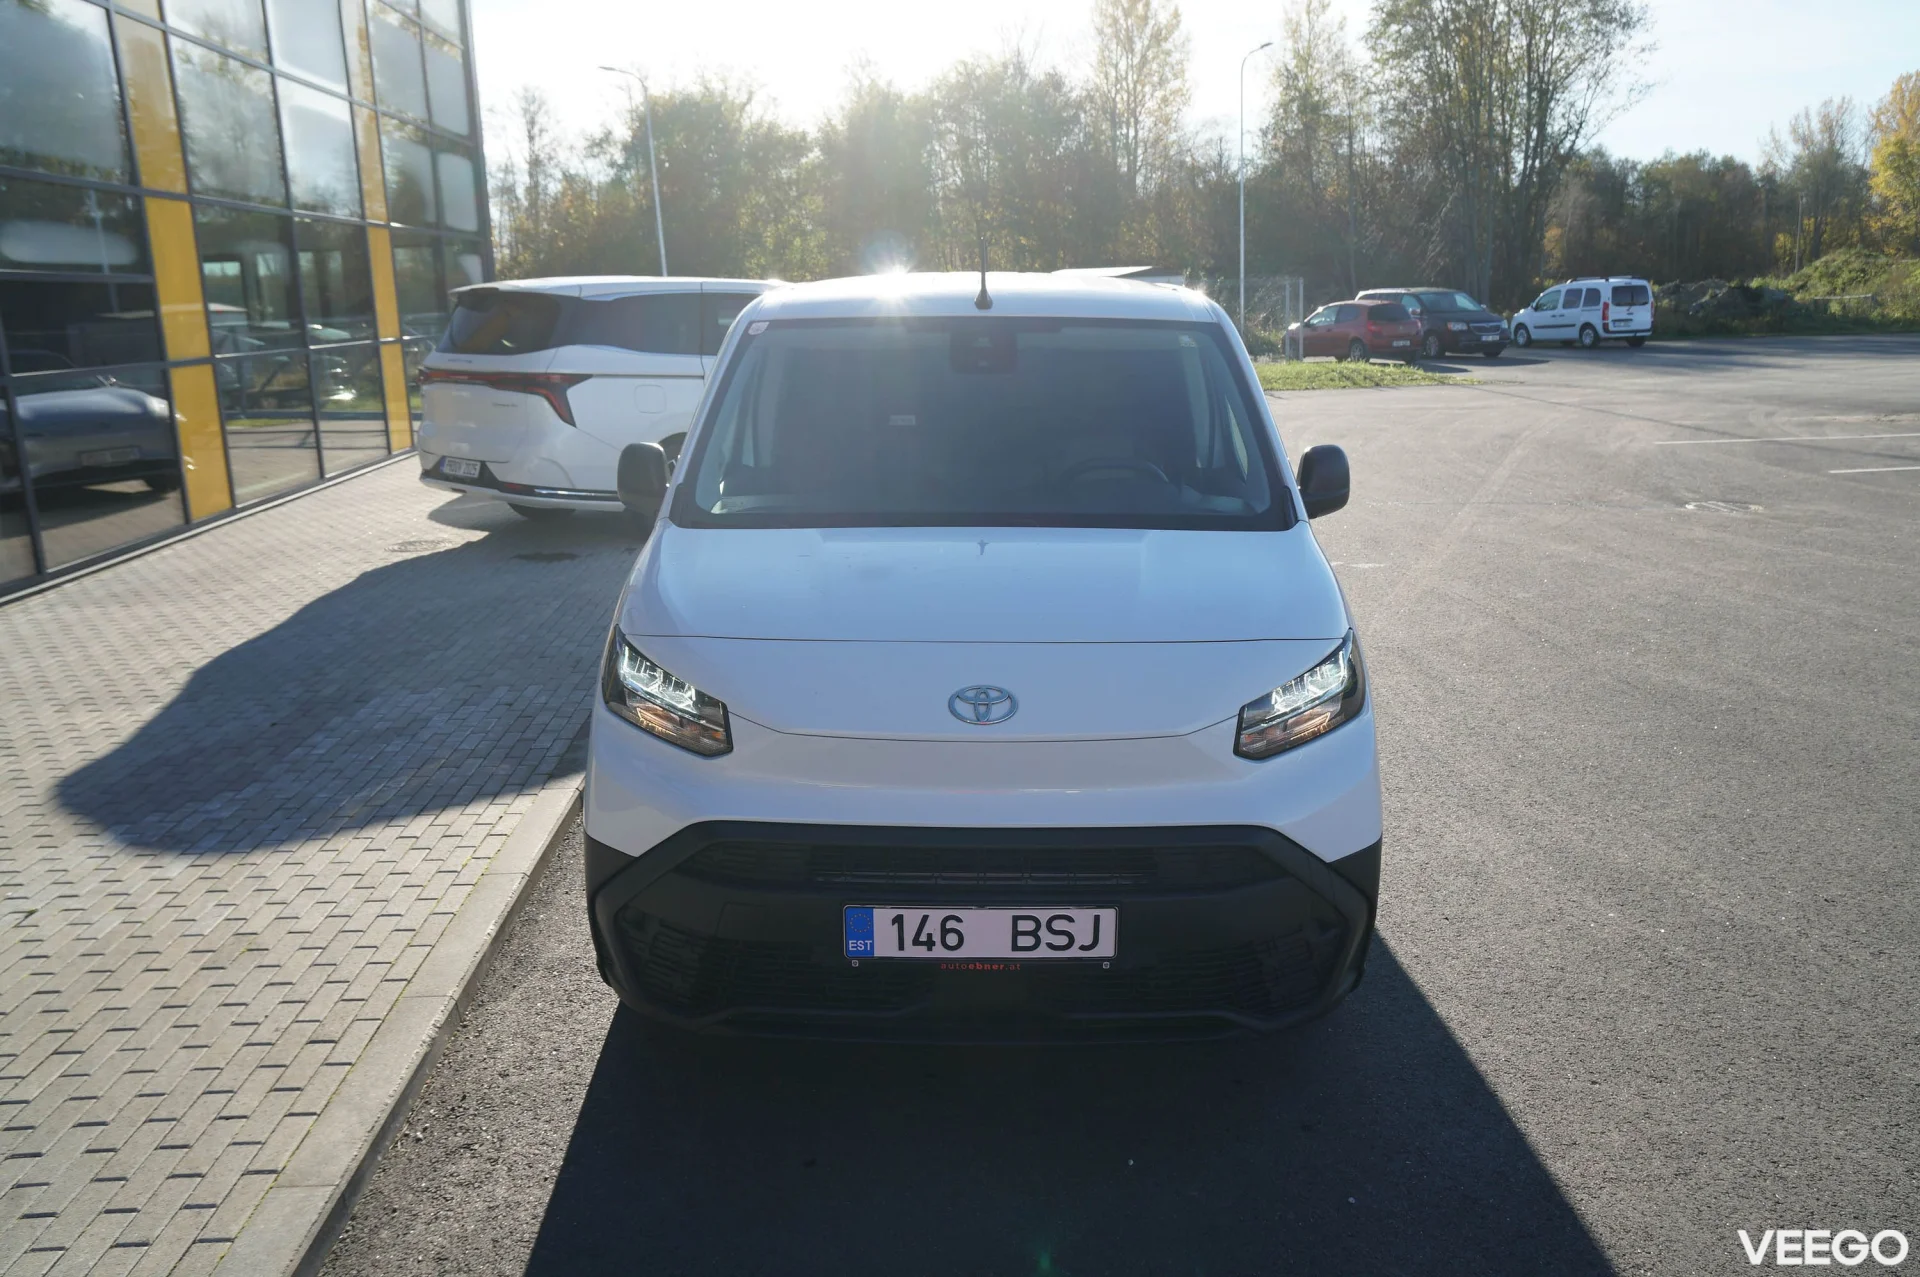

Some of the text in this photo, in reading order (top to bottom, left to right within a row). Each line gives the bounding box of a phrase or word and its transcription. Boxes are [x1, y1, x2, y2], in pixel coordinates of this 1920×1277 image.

[891, 913, 1101, 952] 146 BSJ
[848, 940, 873, 951] EST
[940, 961, 1021, 971] autoebner.at
